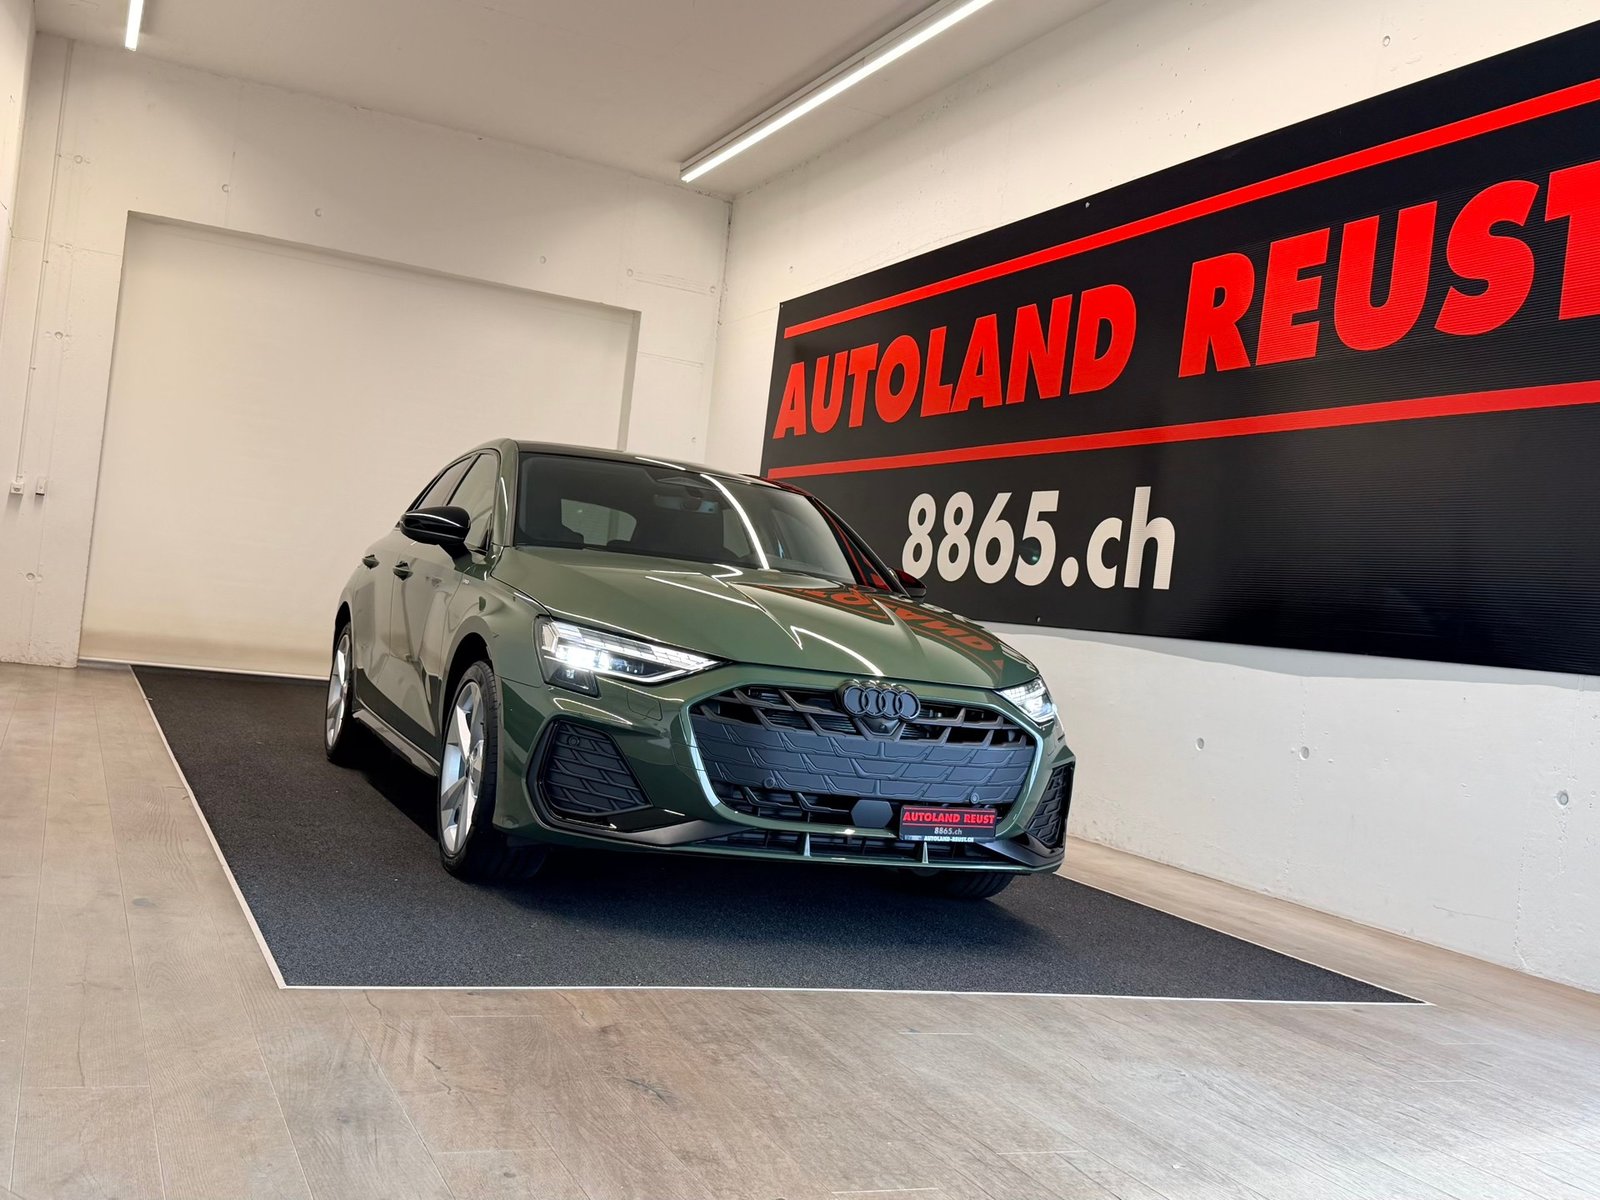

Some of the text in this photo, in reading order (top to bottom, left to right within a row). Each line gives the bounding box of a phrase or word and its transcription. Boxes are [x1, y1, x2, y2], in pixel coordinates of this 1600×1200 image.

[772, 160, 1600, 439] AUTOLAND REUST
[902, 486, 1176, 590] 8865.ch
[903, 811, 995, 824] AUTOLAND REUST
[934, 827, 962, 835] 8865.ch
